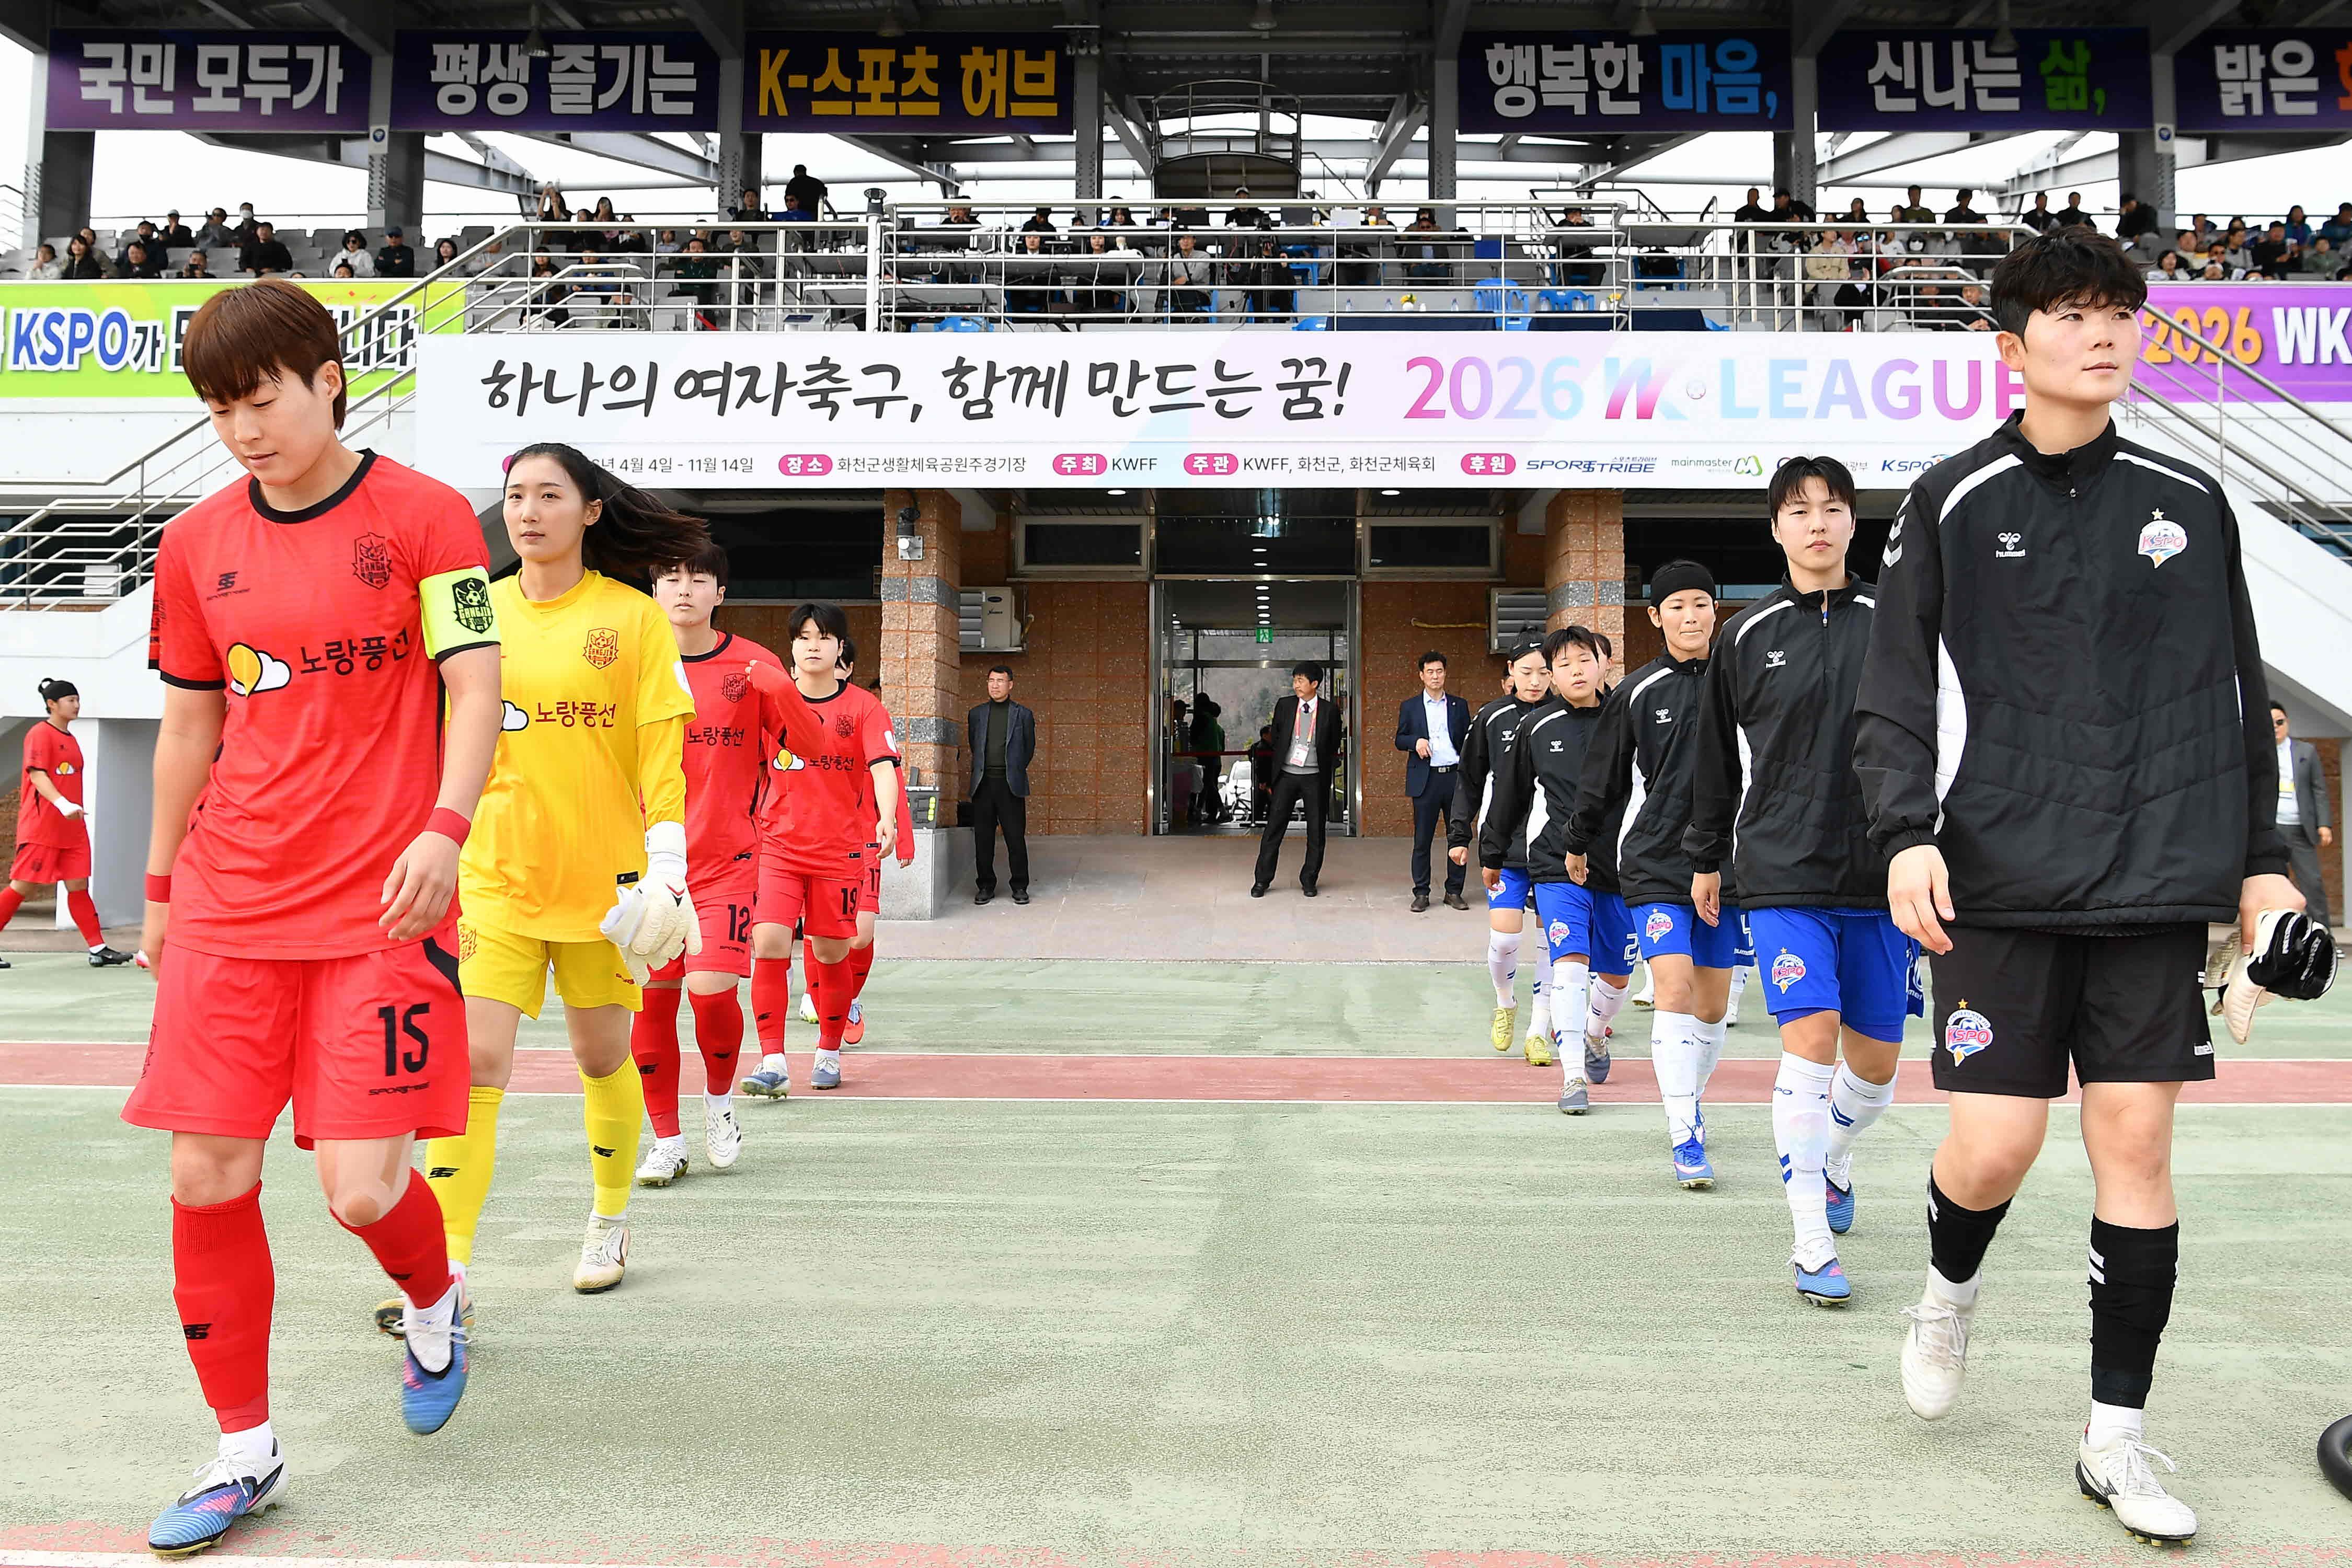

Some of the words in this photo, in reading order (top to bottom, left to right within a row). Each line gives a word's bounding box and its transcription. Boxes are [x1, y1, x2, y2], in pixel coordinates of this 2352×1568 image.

[79, 43, 176, 114] 국민
[192, 44, 343, 116] 모두가
[430, 43, 529, 116] 평생
[548, 44, 696, 114] 즐기는
[759, 47, 939, 117] K-스포츠
[960, 46, 1057, 118] 허브
[1485, 41, 1644, 118] 행복한
[1660, 39, 1777, 119] 마음,
[1868, 40, 2021, 112] 신나는
[2038, 39, 2106, 116] 삶,
[2215, 40, 2319, 117] 밝은
[13, 312, 163, 368] KSPO가
[2143, 306, 2263, 365] 2026
[481, 360, 658, 418] 하나의
[674, 356, 922, 422] 여자축구,
[942, 356, 1069, 421] 함께
[1087, 359, 1261, 419] 만드는
[1276, 357, 1351, 421] 꿈!
[1404, 356, 1585, 420] 2026
[619, 458, 644, 474] 4월
[648, 458, 673, 474] 4일
[689, 458, 717, 474] 11월
[721, 458, 753, 474] 14일
[838, 457, 1026, 472] 화천군생활체육공원주경기장
[1112, 458, 1158, 471] KWFF
[1244, 458, 1292, 474] KWFF,
[1298, 456, 1344, 474] 화천군,
[1350, 456, 1435, 472] 화천군체육회
[1671, 456, 1732, 467] mainmaster
[1881, 459, 1934, 472] KSPO
[2140, 534, 2184, 551] KSPO
[535, 701, 616, 728] 노랑풍선
[687, 727, 745, 747] 노랑풍선
[808, 754, 854, 772] 노랑풍선
[728, 904, 750, 944] 12
[1772, 965, 1805, 980] KSPO
[378, 1001, 431, 1077] 15
[1947, 1028, 1991, 1045] KSPO
